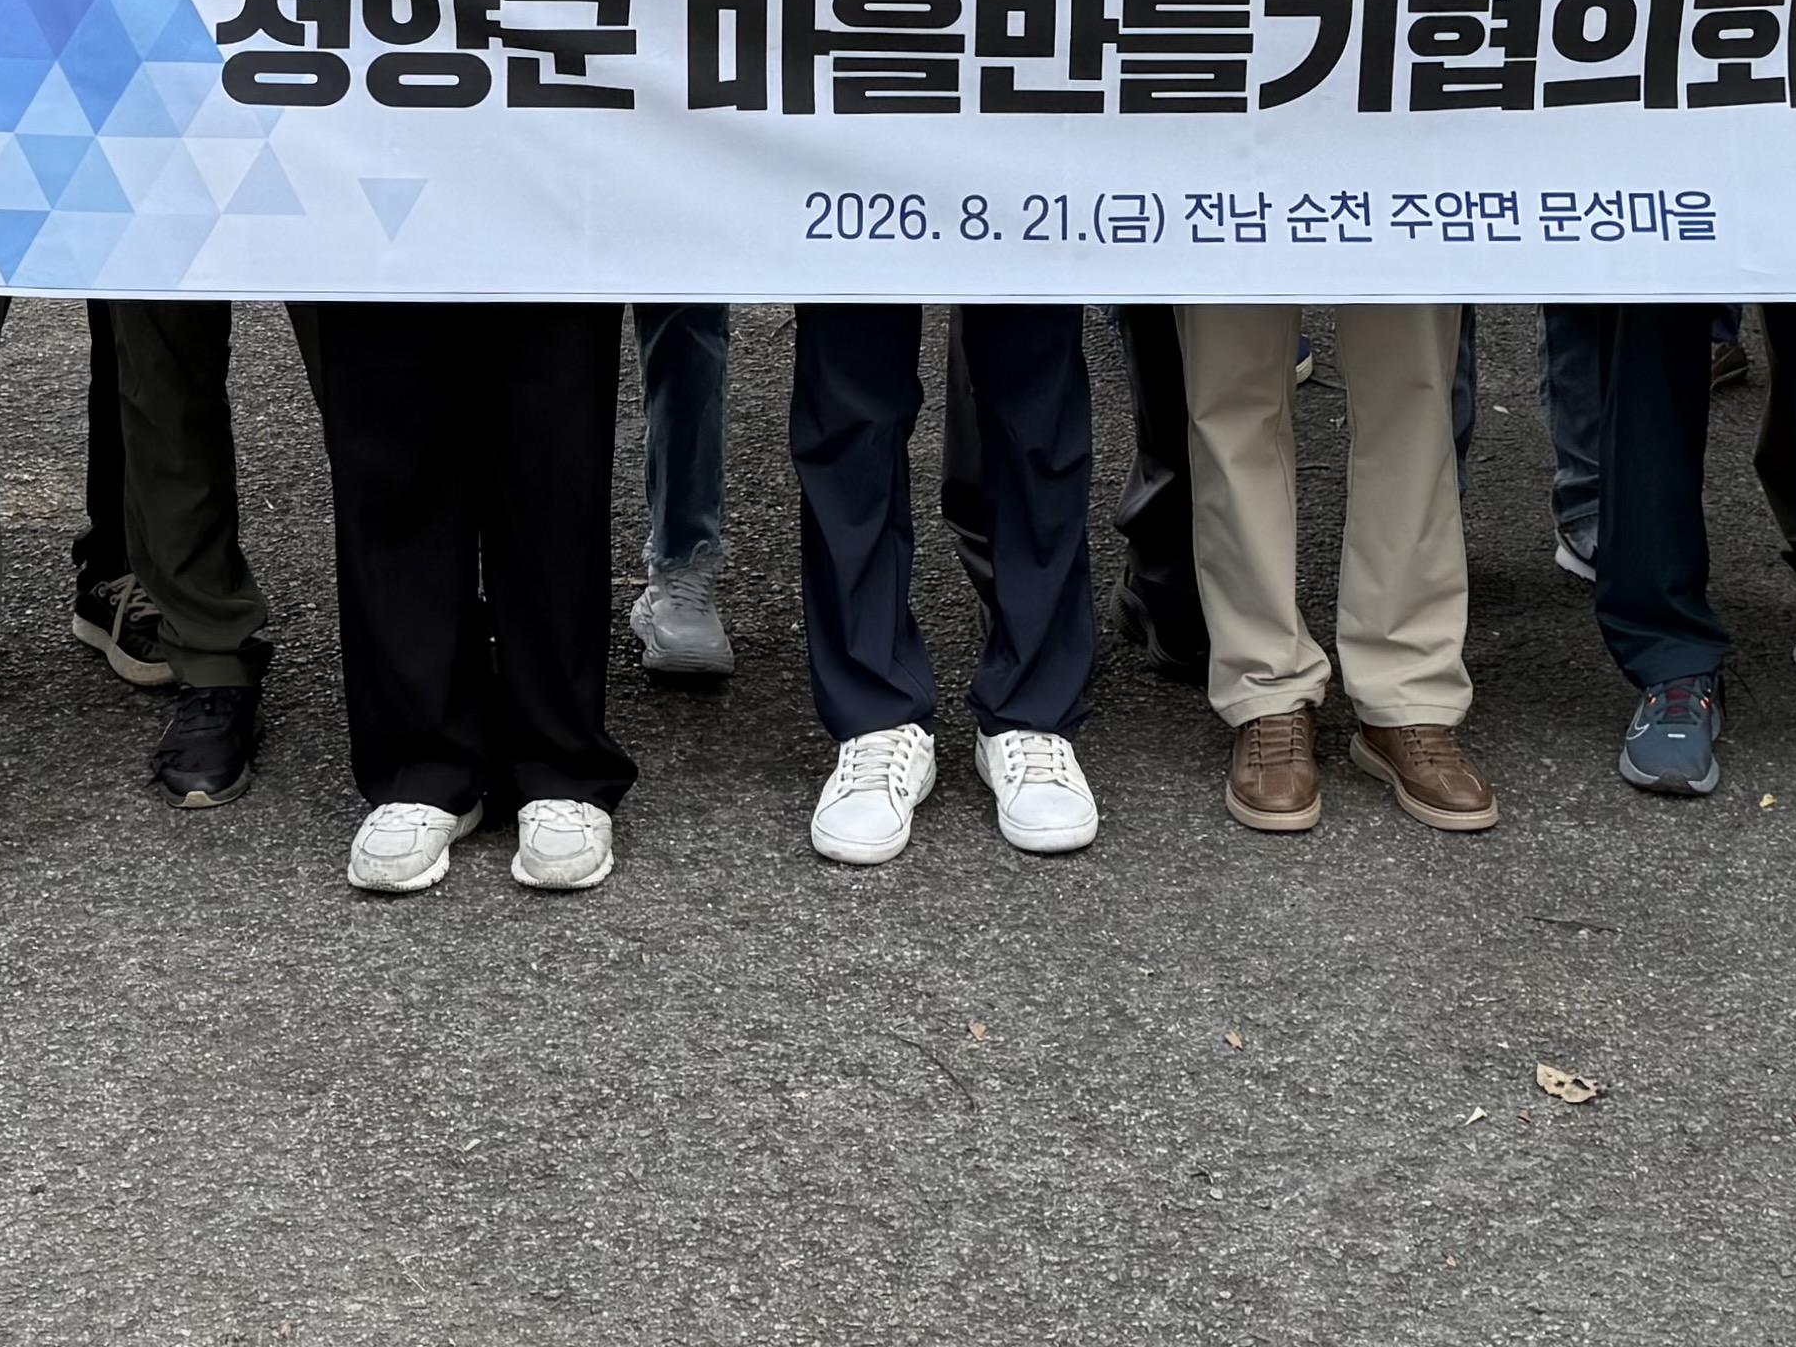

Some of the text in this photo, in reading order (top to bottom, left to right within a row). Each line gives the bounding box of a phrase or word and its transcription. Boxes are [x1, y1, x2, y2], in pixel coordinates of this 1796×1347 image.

[805, 189, 1717, 244] 2026. 8. 21.(금) 전남 순천 주암면 문성마을
